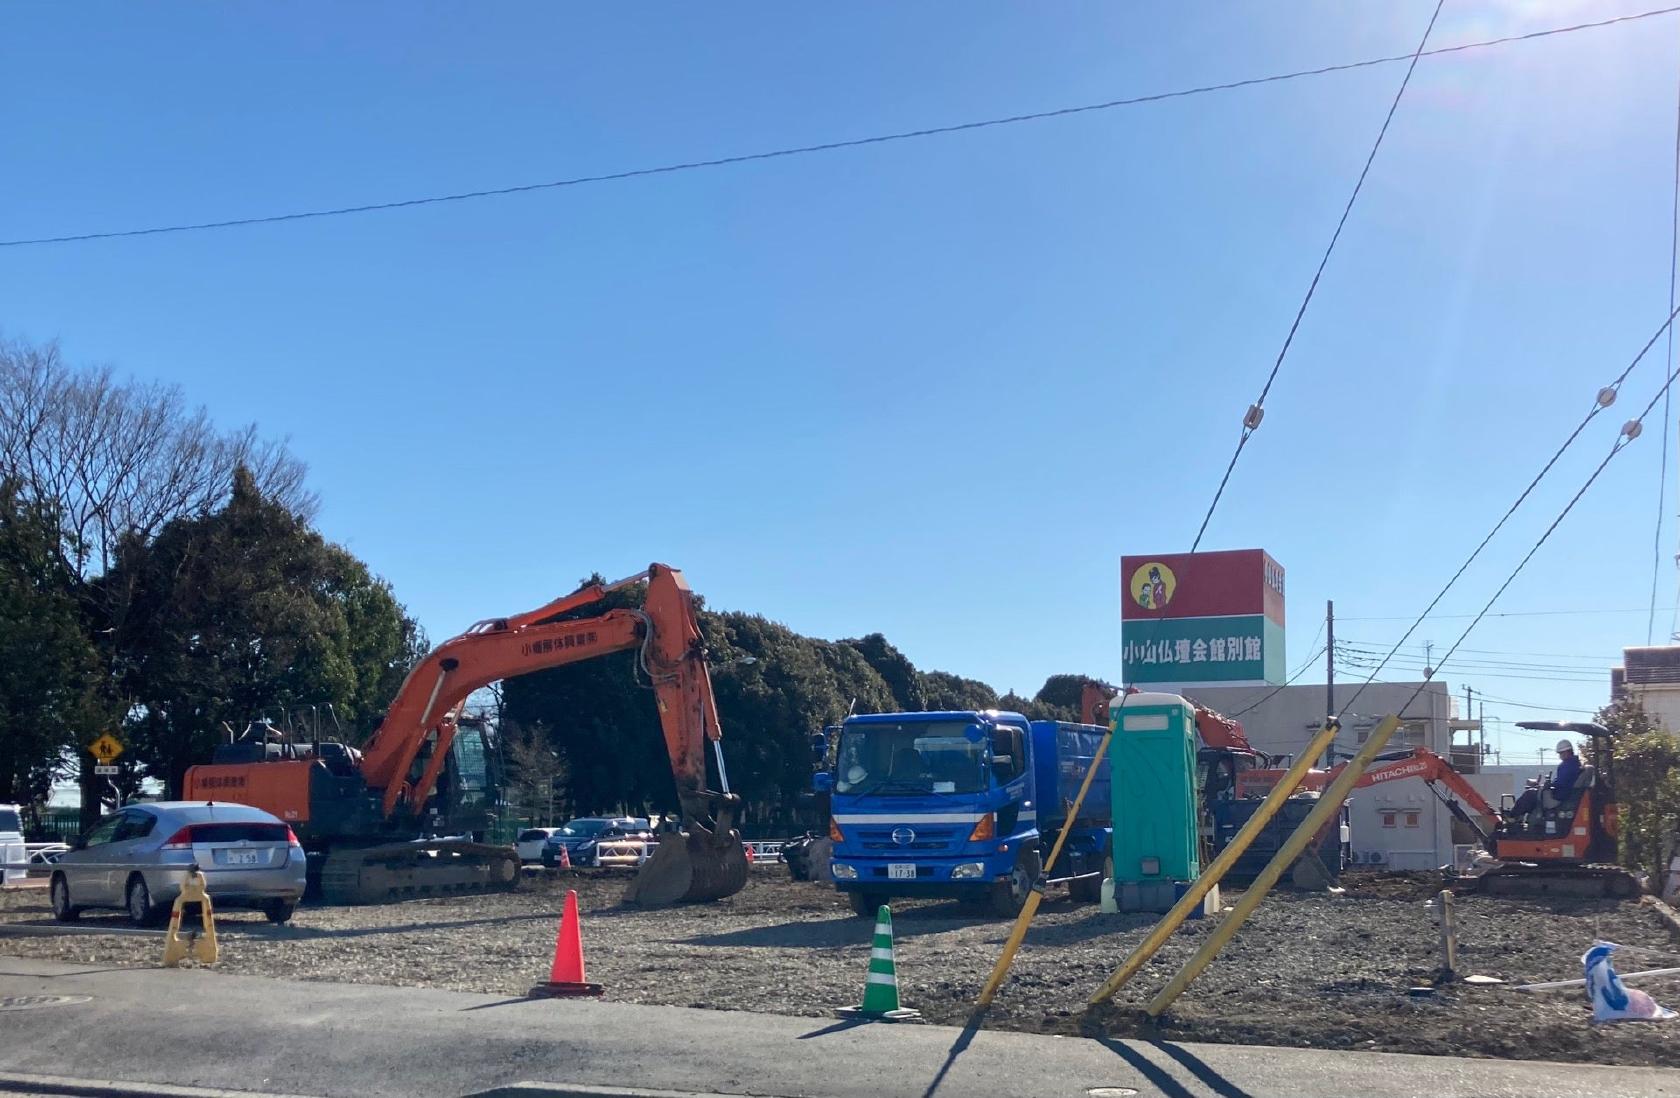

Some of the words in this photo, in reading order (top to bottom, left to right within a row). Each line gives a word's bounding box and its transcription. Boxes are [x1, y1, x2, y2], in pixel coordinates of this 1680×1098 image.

[1123, 636, 1262, 665] 小山仏壇会館別館
[1371, 766, 1411, 782] HITACHI
